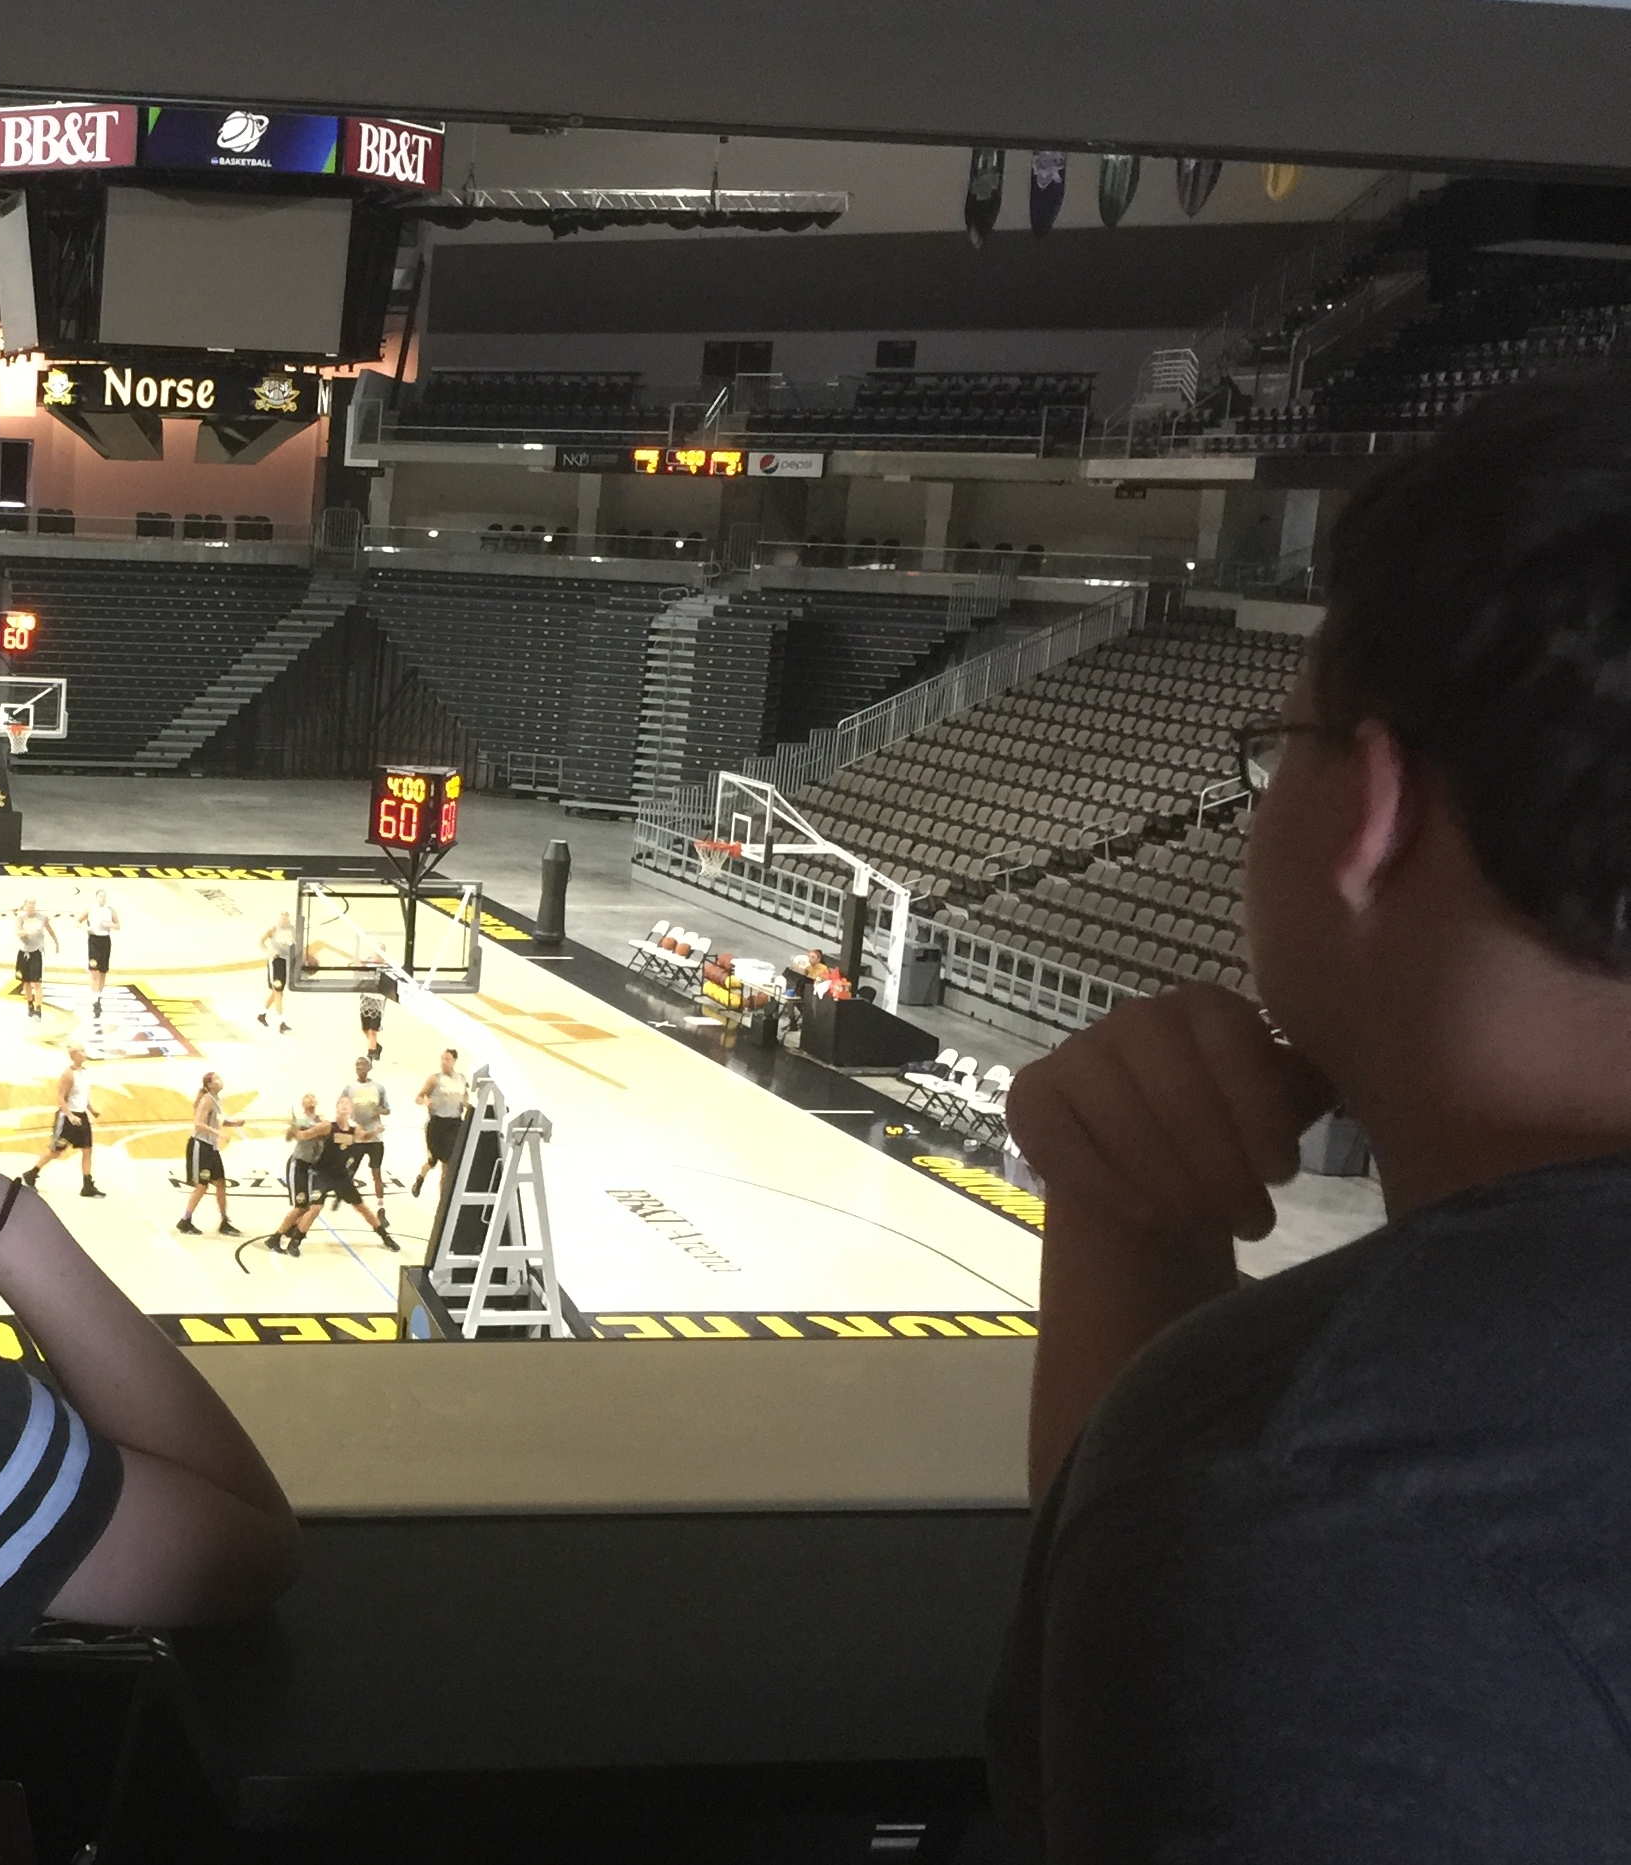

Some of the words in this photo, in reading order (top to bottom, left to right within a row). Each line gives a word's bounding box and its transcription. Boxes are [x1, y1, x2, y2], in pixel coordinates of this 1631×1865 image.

[0, 111, 119, 167] BB&T
[357, 122, 433, 185] BB&T
[219, 158, 272, 167] BASKETBALL
[103, 366, 216, 408] Norse
[562, 452, 589, 468] NKU
[780, 459, 812, 472] pepsi
[3, 628, 29, 650] 60
[379, 799, 418, 842] 60
[4, 864, 287, 881] KENTUCKY
[605, 1189, 695, 1227] BB&T
[655, 1228, 742, 1273] Arena
